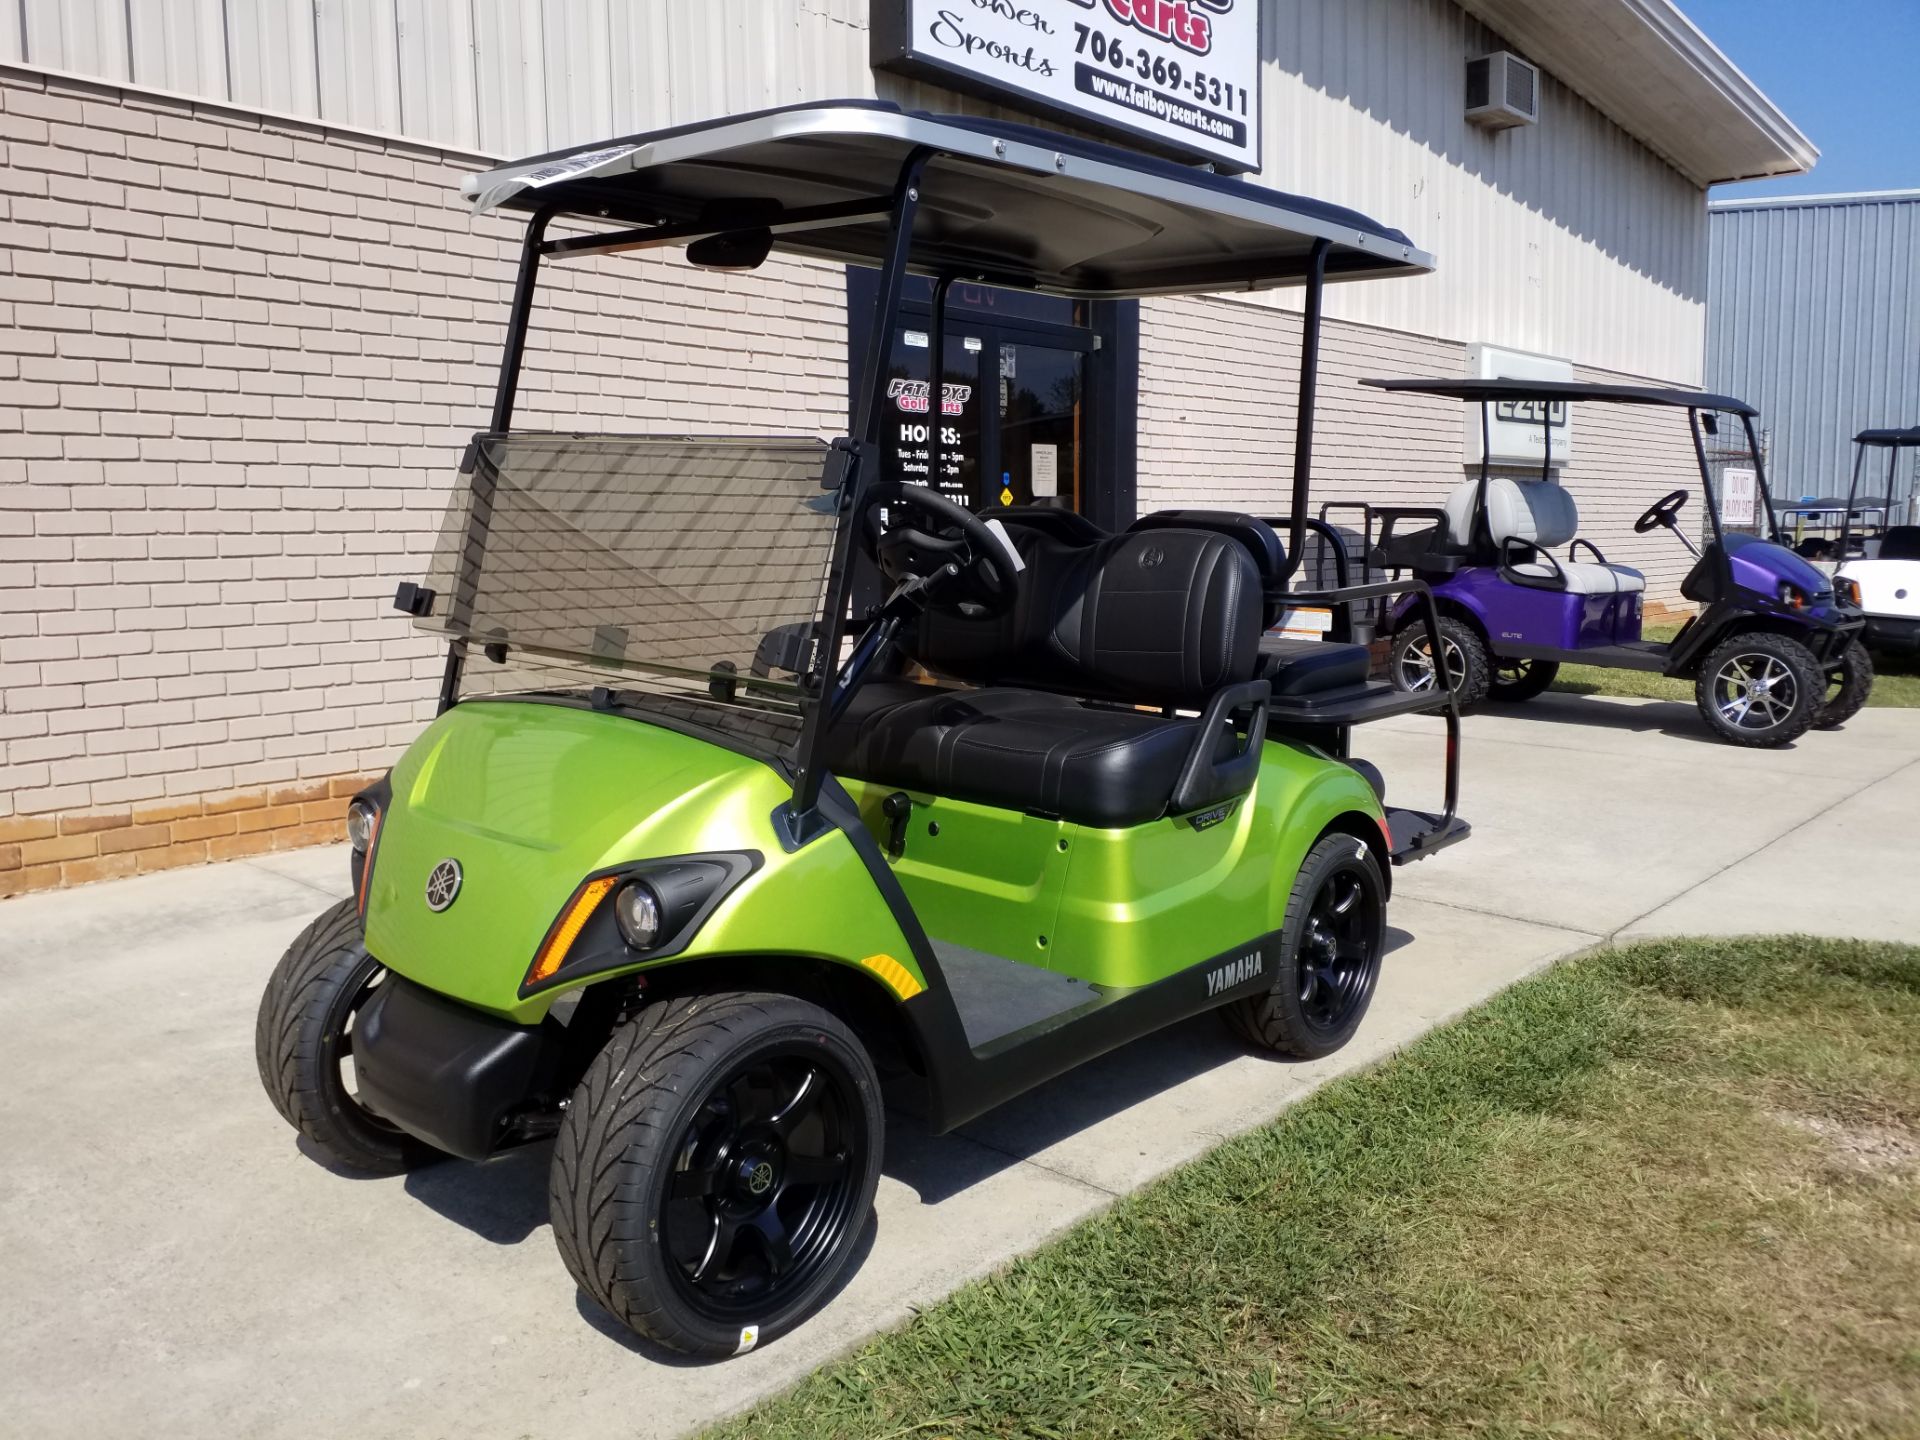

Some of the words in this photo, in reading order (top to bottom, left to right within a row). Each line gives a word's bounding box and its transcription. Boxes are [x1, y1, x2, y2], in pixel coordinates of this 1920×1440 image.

[929, 10, 1060, 77] Sports
[1074, 21, 1247, 117] 706-369-5311
[1091, 75, 1234, 139] www.fatboyscarts.com
[899, 396, 929, 412] Golf
[900, 424, 961, 445] HORS:
[898, 449, 911, 459] Tues
[916, 449, 929, 459] Frid
[903, 462, 929, 475] Saturday
[1740, 476, 1749, 495] NOT
[1195, 807, 1226, 825] DRIVE
[1206, 950, 1263, 998] YAMAHA
